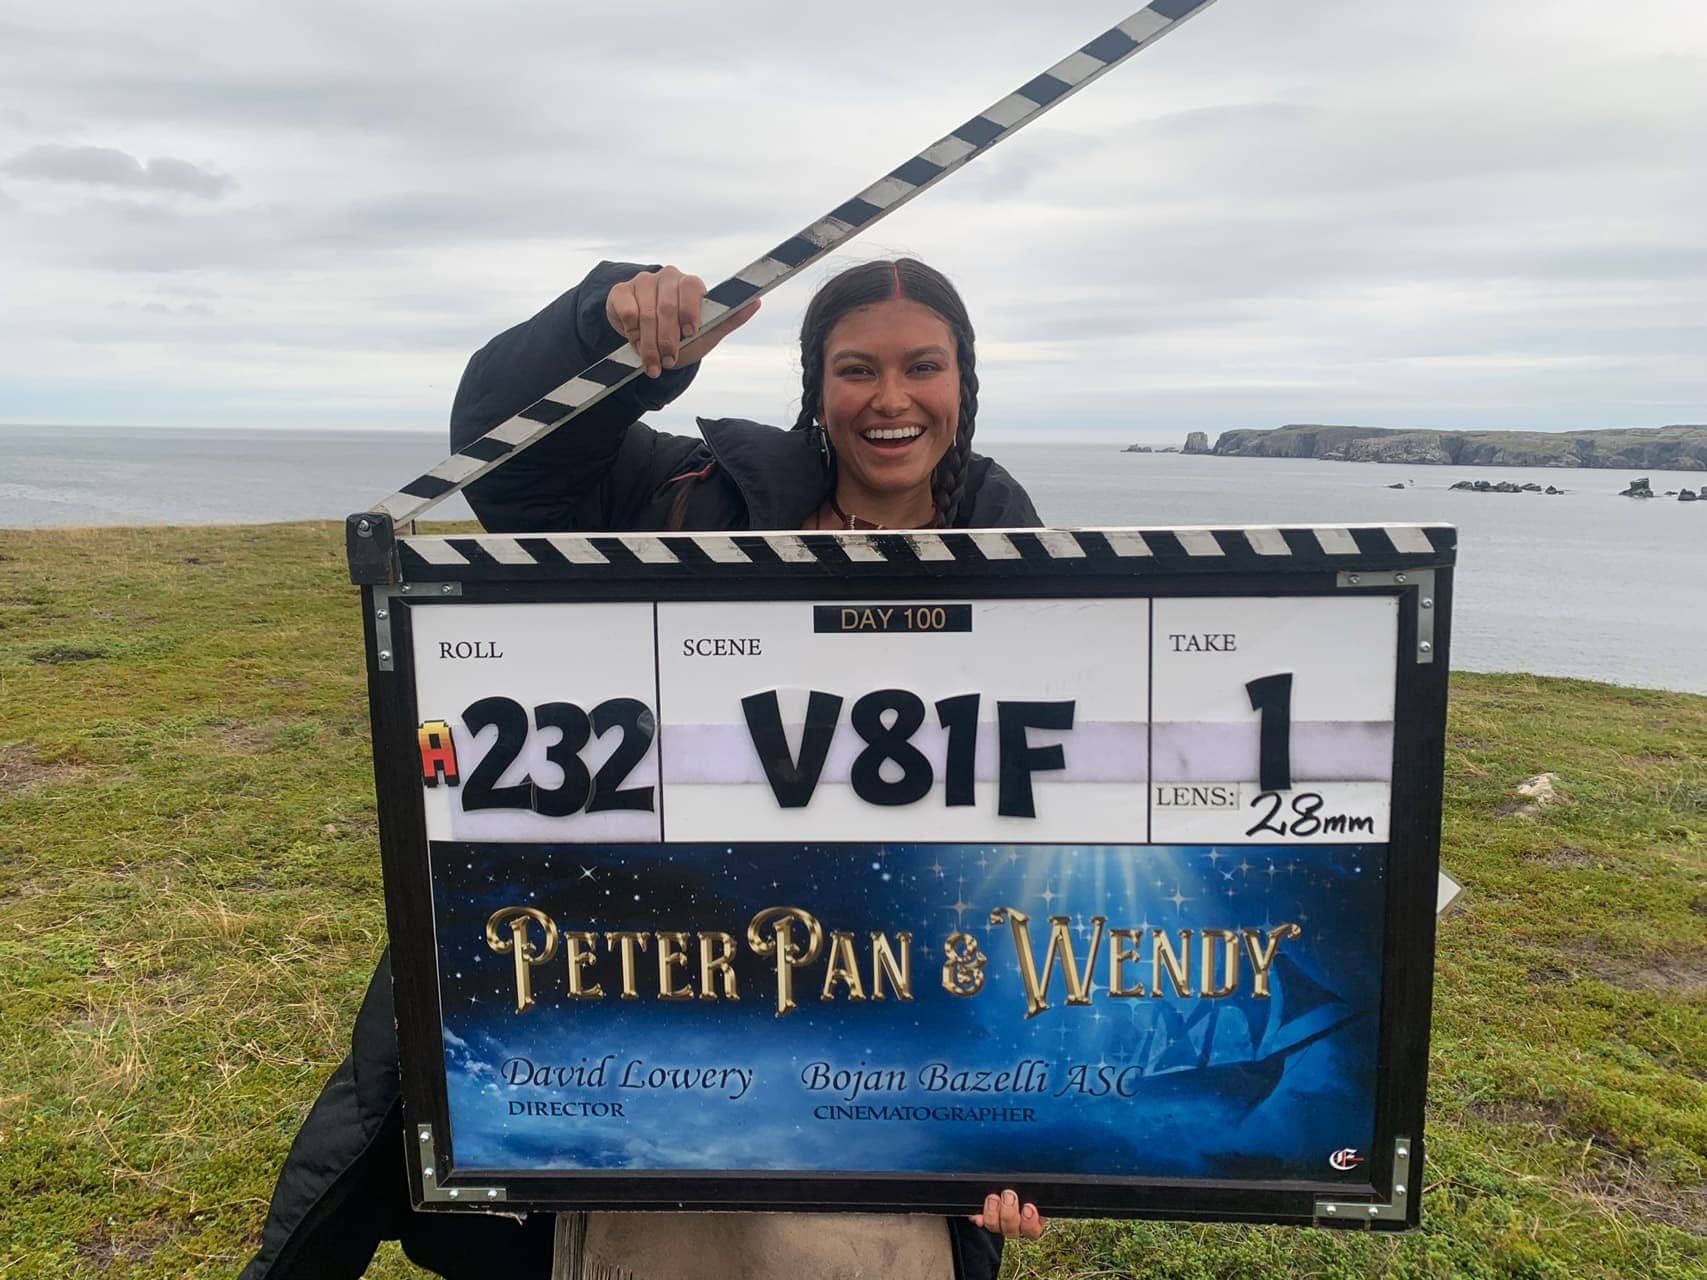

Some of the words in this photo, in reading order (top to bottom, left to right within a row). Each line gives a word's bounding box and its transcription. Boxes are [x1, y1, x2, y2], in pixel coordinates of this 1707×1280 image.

[841, 608, 894, 629] DAY
[904, 607, 946, 629] 100
[439, 641, 504, 659] ROLL
[682, 638, 762, 657] SCENE
[1169, 633, 1237, 652] TAKE
[1245, 672, 1293, 791] 1
[740, 688, 1076, 819] V81F
[1156, 786, 1235, 807] LENS:
[1245, 792, 1375, 838] 28mm
[486, 906, 740, 1016] PETER
[747, 906, 914, 1018] PAN
[942, 932, 988, 997] &
[990, 906, 1302, 1020] WENDY
[501, 1055, 615, 1089] David
[618, 1059, 753, 1100] Lowery
[801, 1061, 907, 1101] Bojan
[918, 1060, 1047, 1094] Bazelli
[1053, 1064, 1145, 1098] ASC
[508, 1101, 625, 1118] DIRECTOR
[813, 1105, 1036, 1123] CINEMATOGRAPHER
